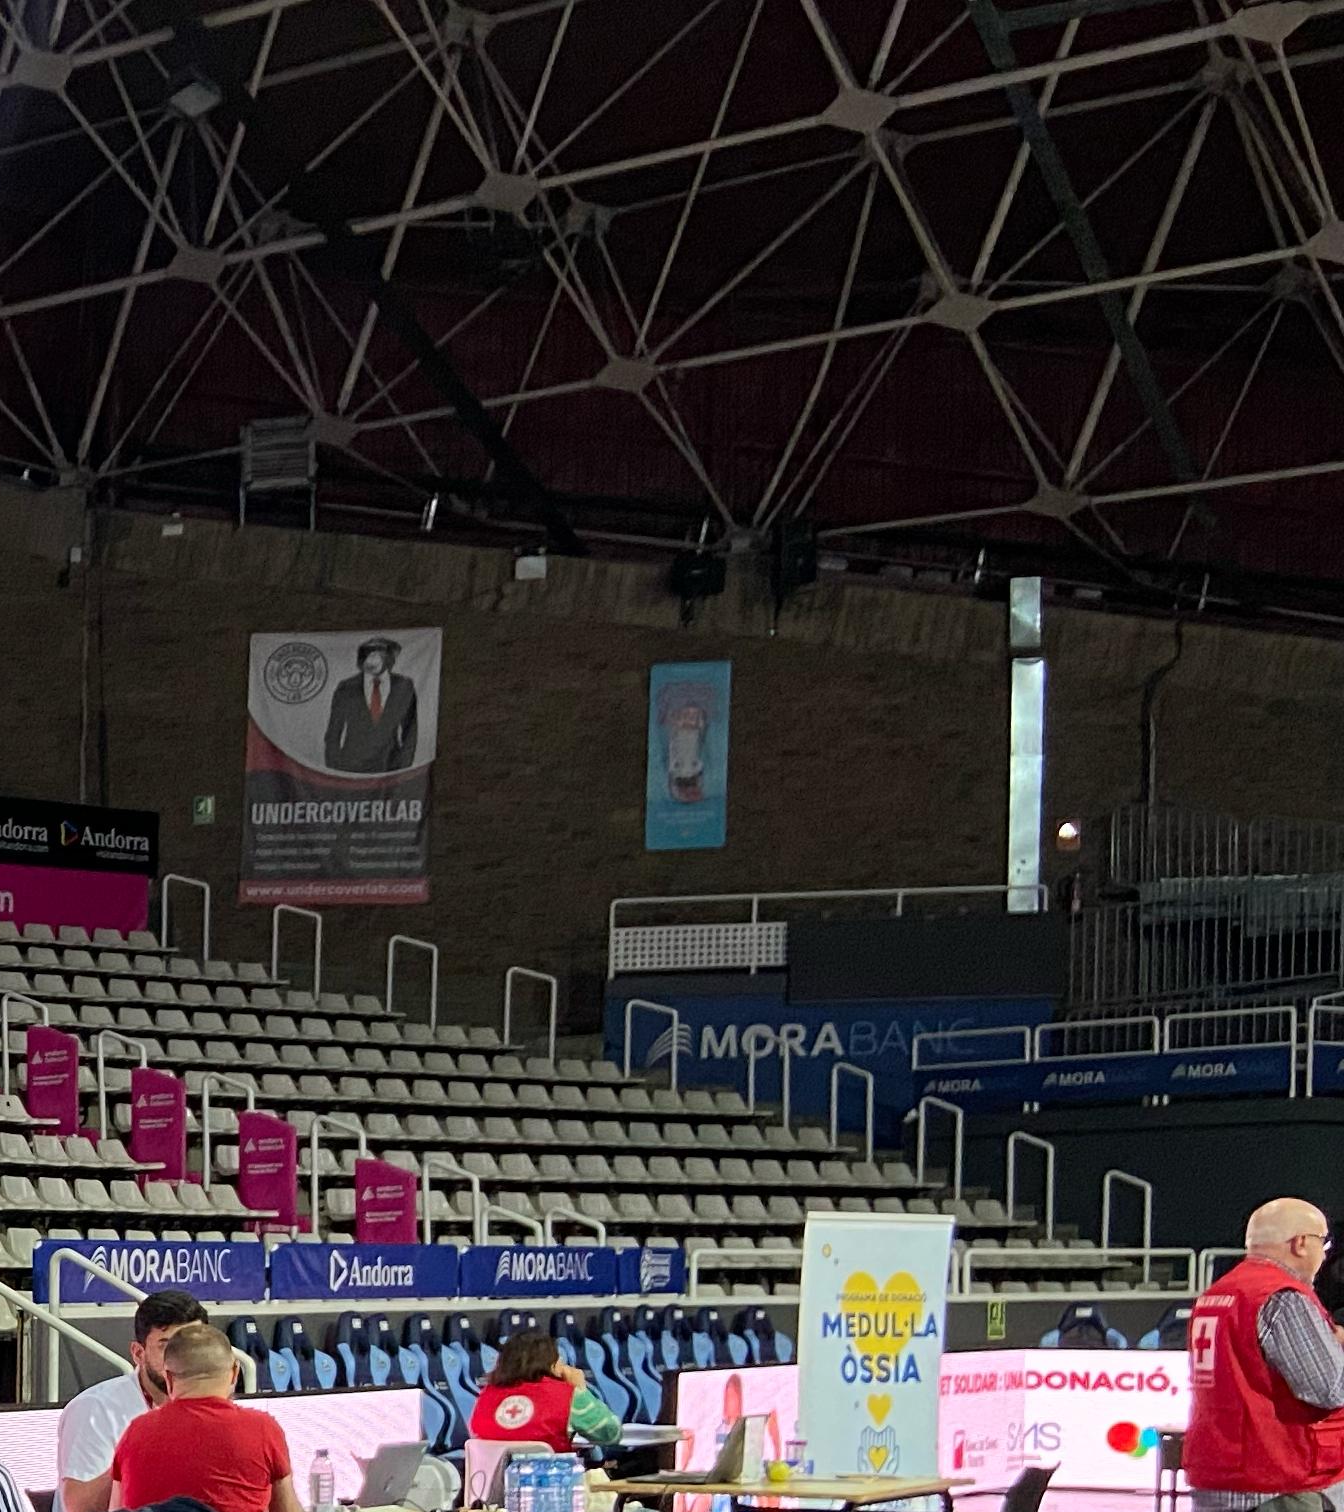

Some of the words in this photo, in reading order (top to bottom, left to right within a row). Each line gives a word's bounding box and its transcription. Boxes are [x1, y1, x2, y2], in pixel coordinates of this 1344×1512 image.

[251, 800, 423, 825] UNDERCOVERLAB
[80, 826, 150, 851] Andorra
[246, 883, 423, 897] www.undercoverlab.com
[699, 1018, 976, 1058] MORABANC
[110, 1248, 232, 1284] MORABANC
[348, 1256, 414, 1287] Andorra
[511, 1251, 594, 1282] MORABANC
[822, 1311, 938, 1338] MEDUL·LA
[841, 1343, 921, 1384] ÒSSIA
[1026, 1366, 1179, 1396] DONACIÓ,
